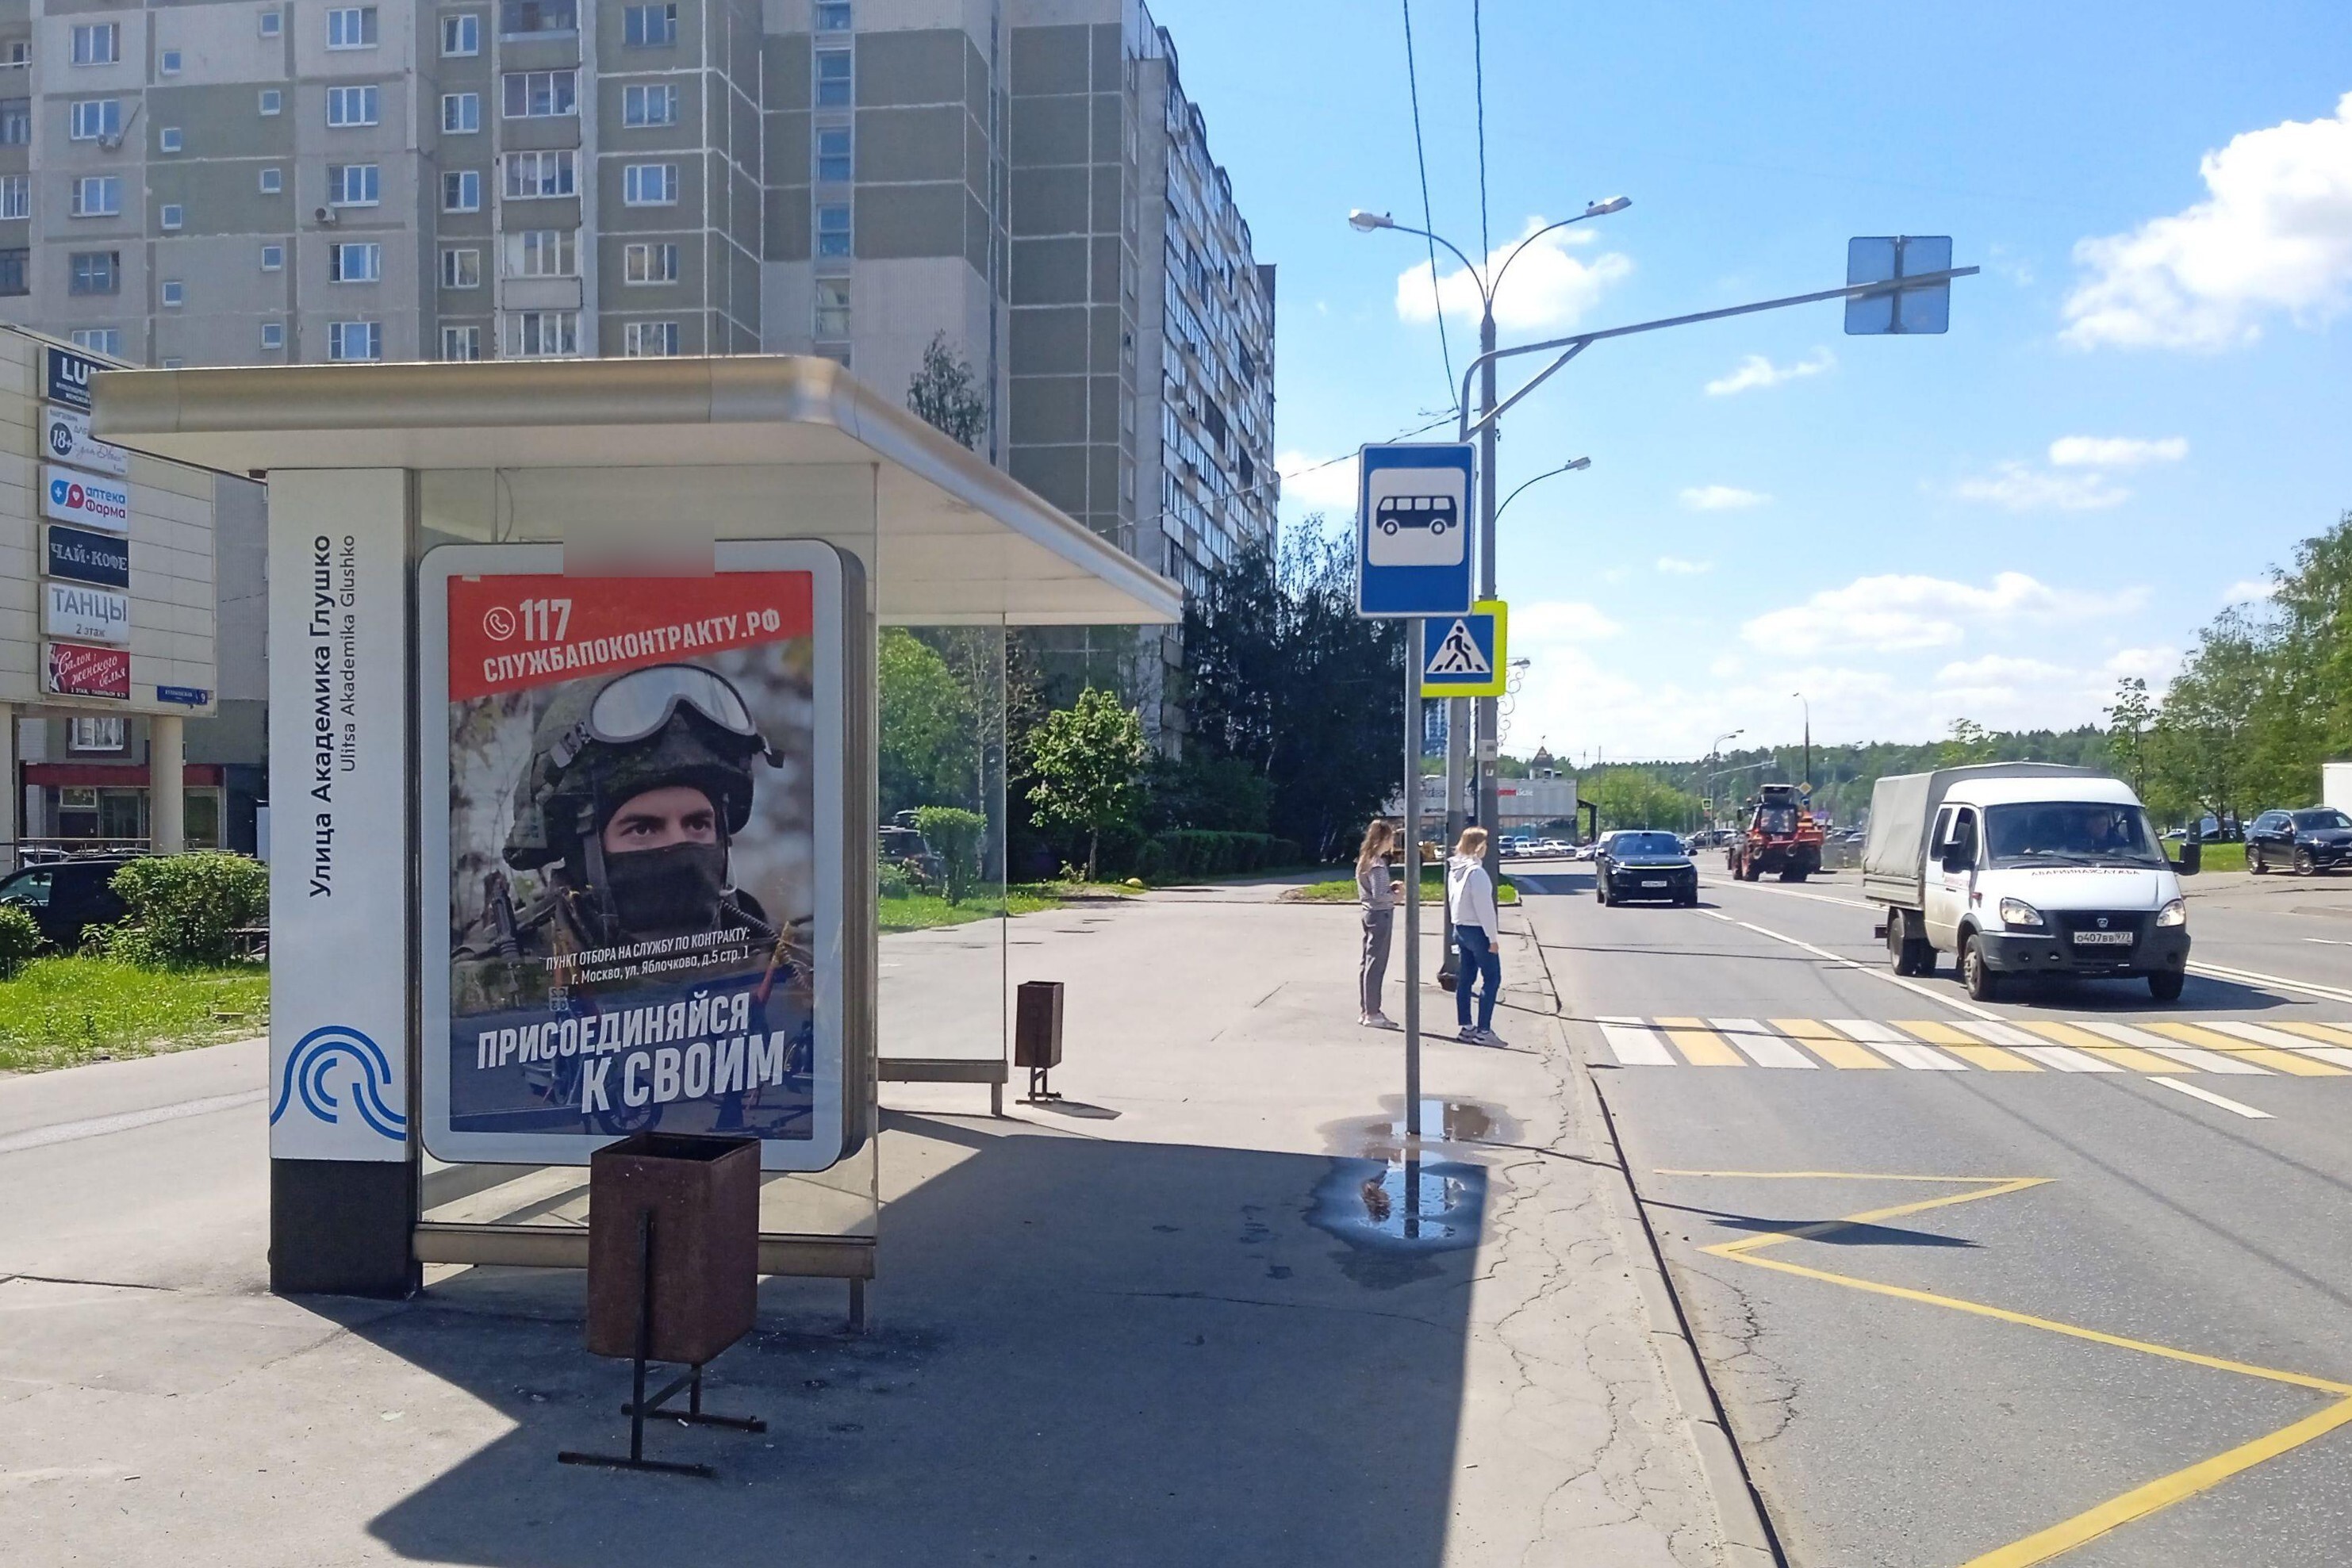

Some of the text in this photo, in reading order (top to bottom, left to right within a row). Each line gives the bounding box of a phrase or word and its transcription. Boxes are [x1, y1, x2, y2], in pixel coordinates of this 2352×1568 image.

[62, 357, 97, 385] LU
[53, 430, 73, 449] 18+
[86, 487, 125, 504] аптека
[86, 499, 125, 519] Фарма
[52, 588, 126, 623] ТАНЦЫ
[520, 599, 572, 641] 117
[76, 623, 82, 634] 2
[483, 608, 781, 683] СЛУЖБАПОКОНТРАКТУ.РФ
[59, 651, 90, 675] Салон
[340, 535, 355, 772] Ulitsa Akademika Glushko
[309, 535, 336, 897] Улица Академика Глушко
[546, 926, 750, 971] ПУНКТ ОТБОРА НА СЛУЖБУ ПО КОНТРАКТУ:
[571, 974, 578, 985] г.
[581, 968, 623, 984] Москва,
[624, 965, 639, 980] ул.
[641, 956, 700, 975] Яблочкова,
[720, 949, 741, 964] стр.
[742, 945, 749, 959] 1
[478, 991, 750, 1069] ПРИСОЕДИНЯЙСЯ
[581, 1031, 785, 1114] К СВОИМ
